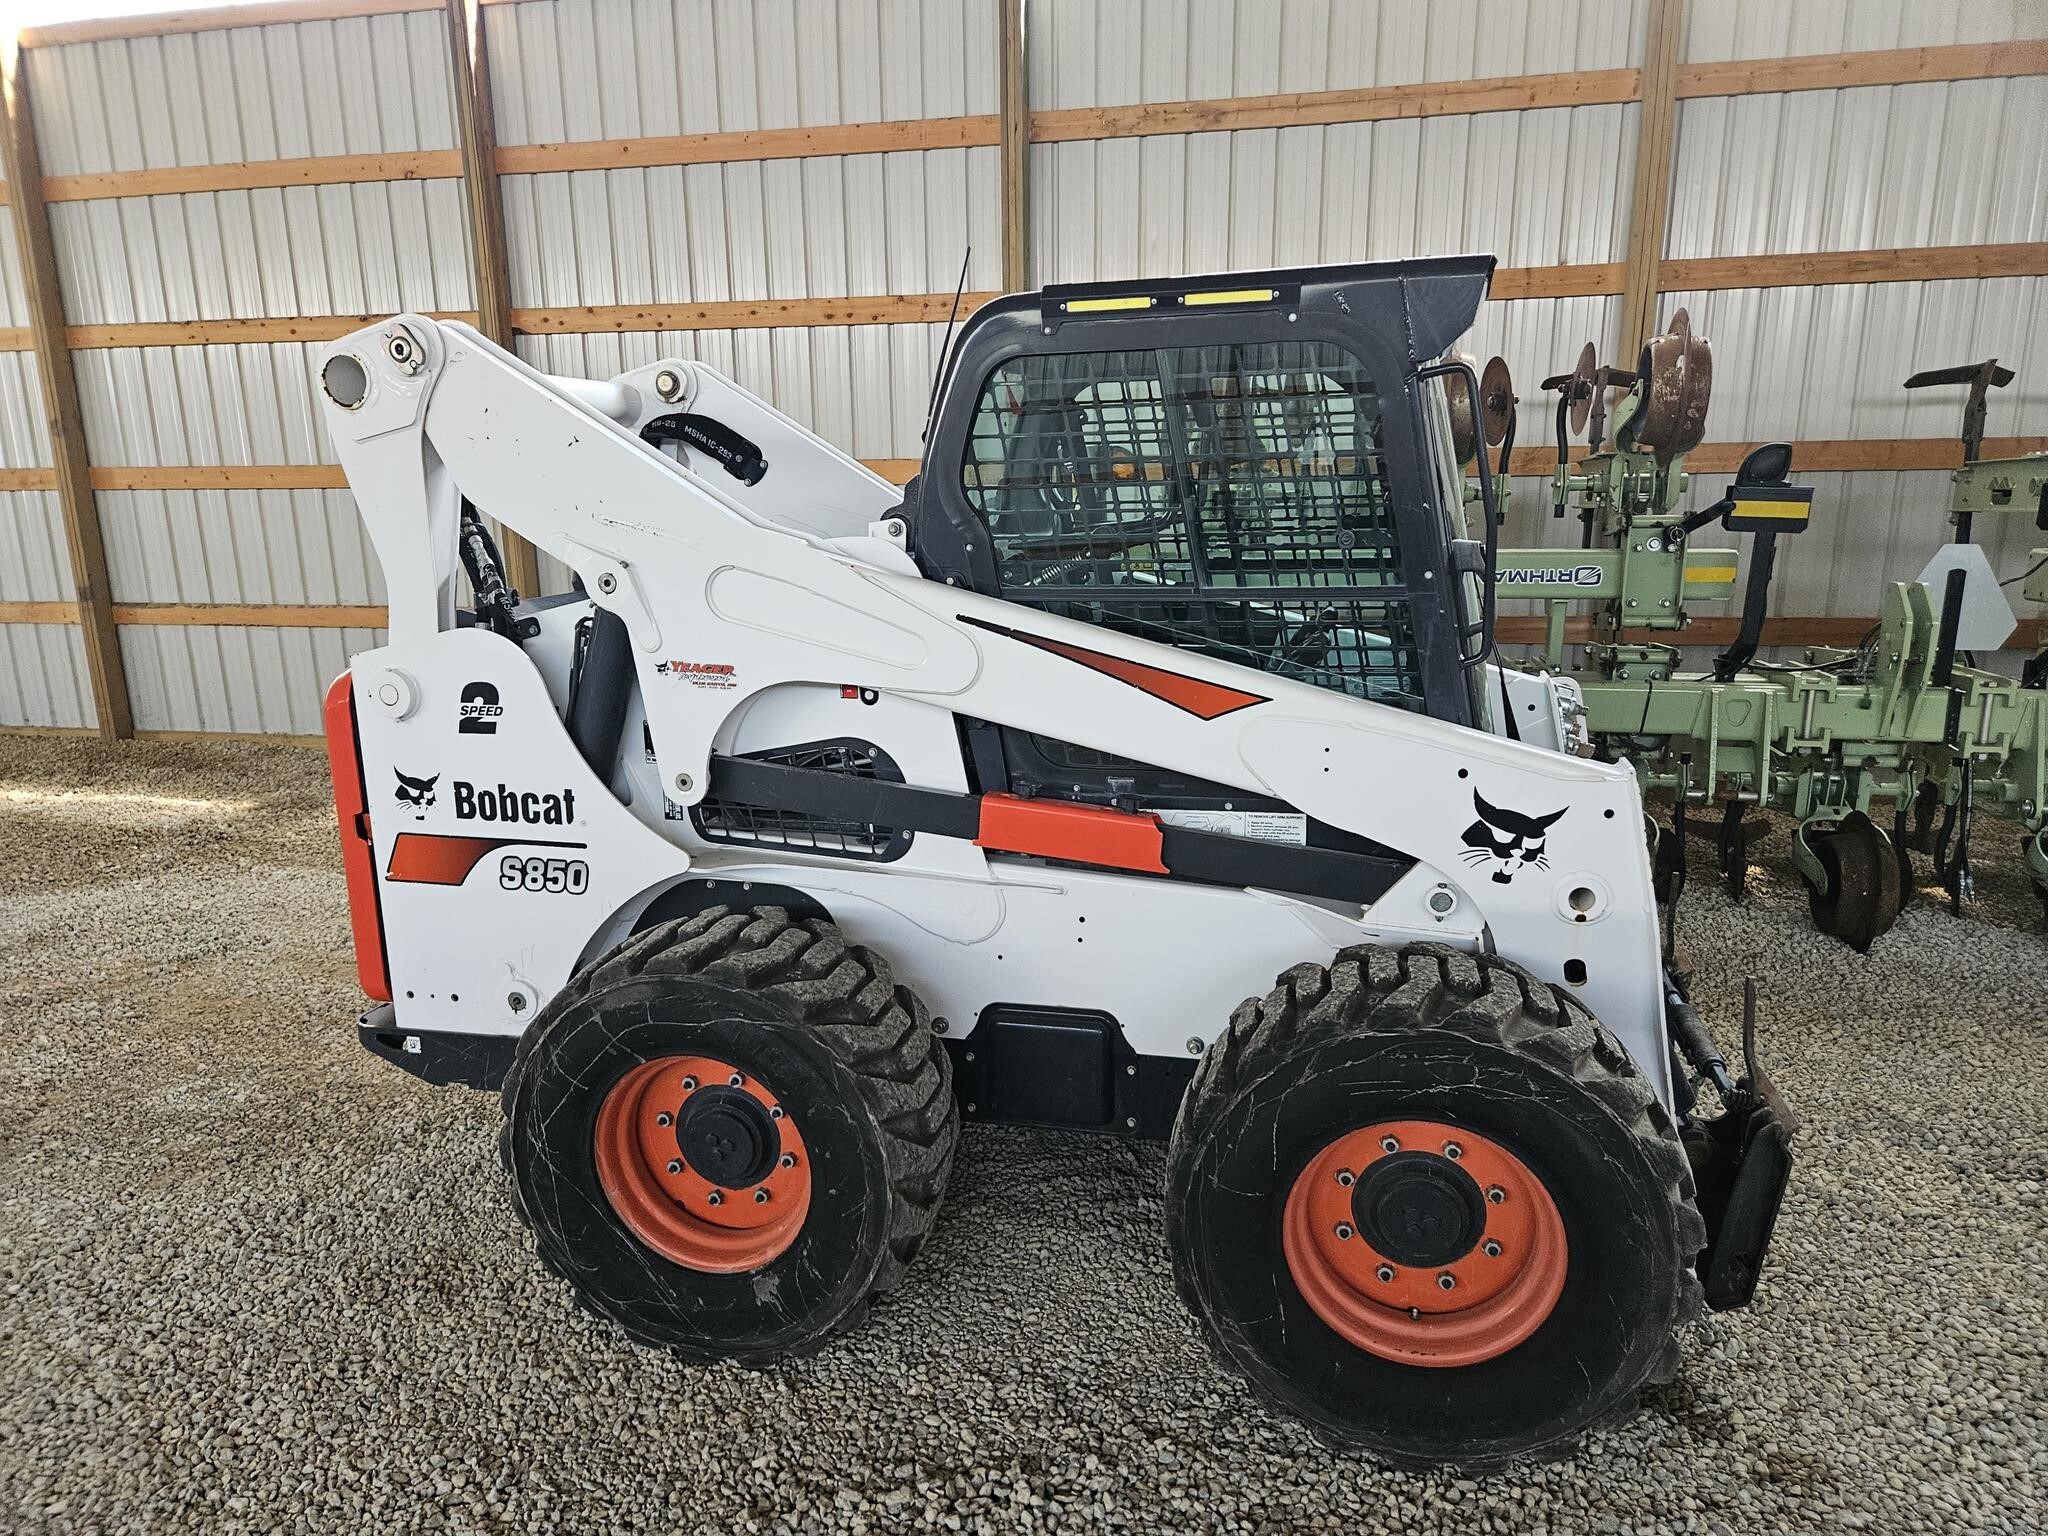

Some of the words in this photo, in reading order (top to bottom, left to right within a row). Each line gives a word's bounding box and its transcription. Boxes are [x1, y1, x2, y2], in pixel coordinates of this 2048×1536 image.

[685, 425, 707, 443] MSHA
[1495, 566, 1602, 586] ORTHMA
[670, 660, 737, 676] YEAGER
[459, 704, 504, 718] SPEED
[452, 780, 575, 826] Bobcat
[499, 855, 589, 896] S850
